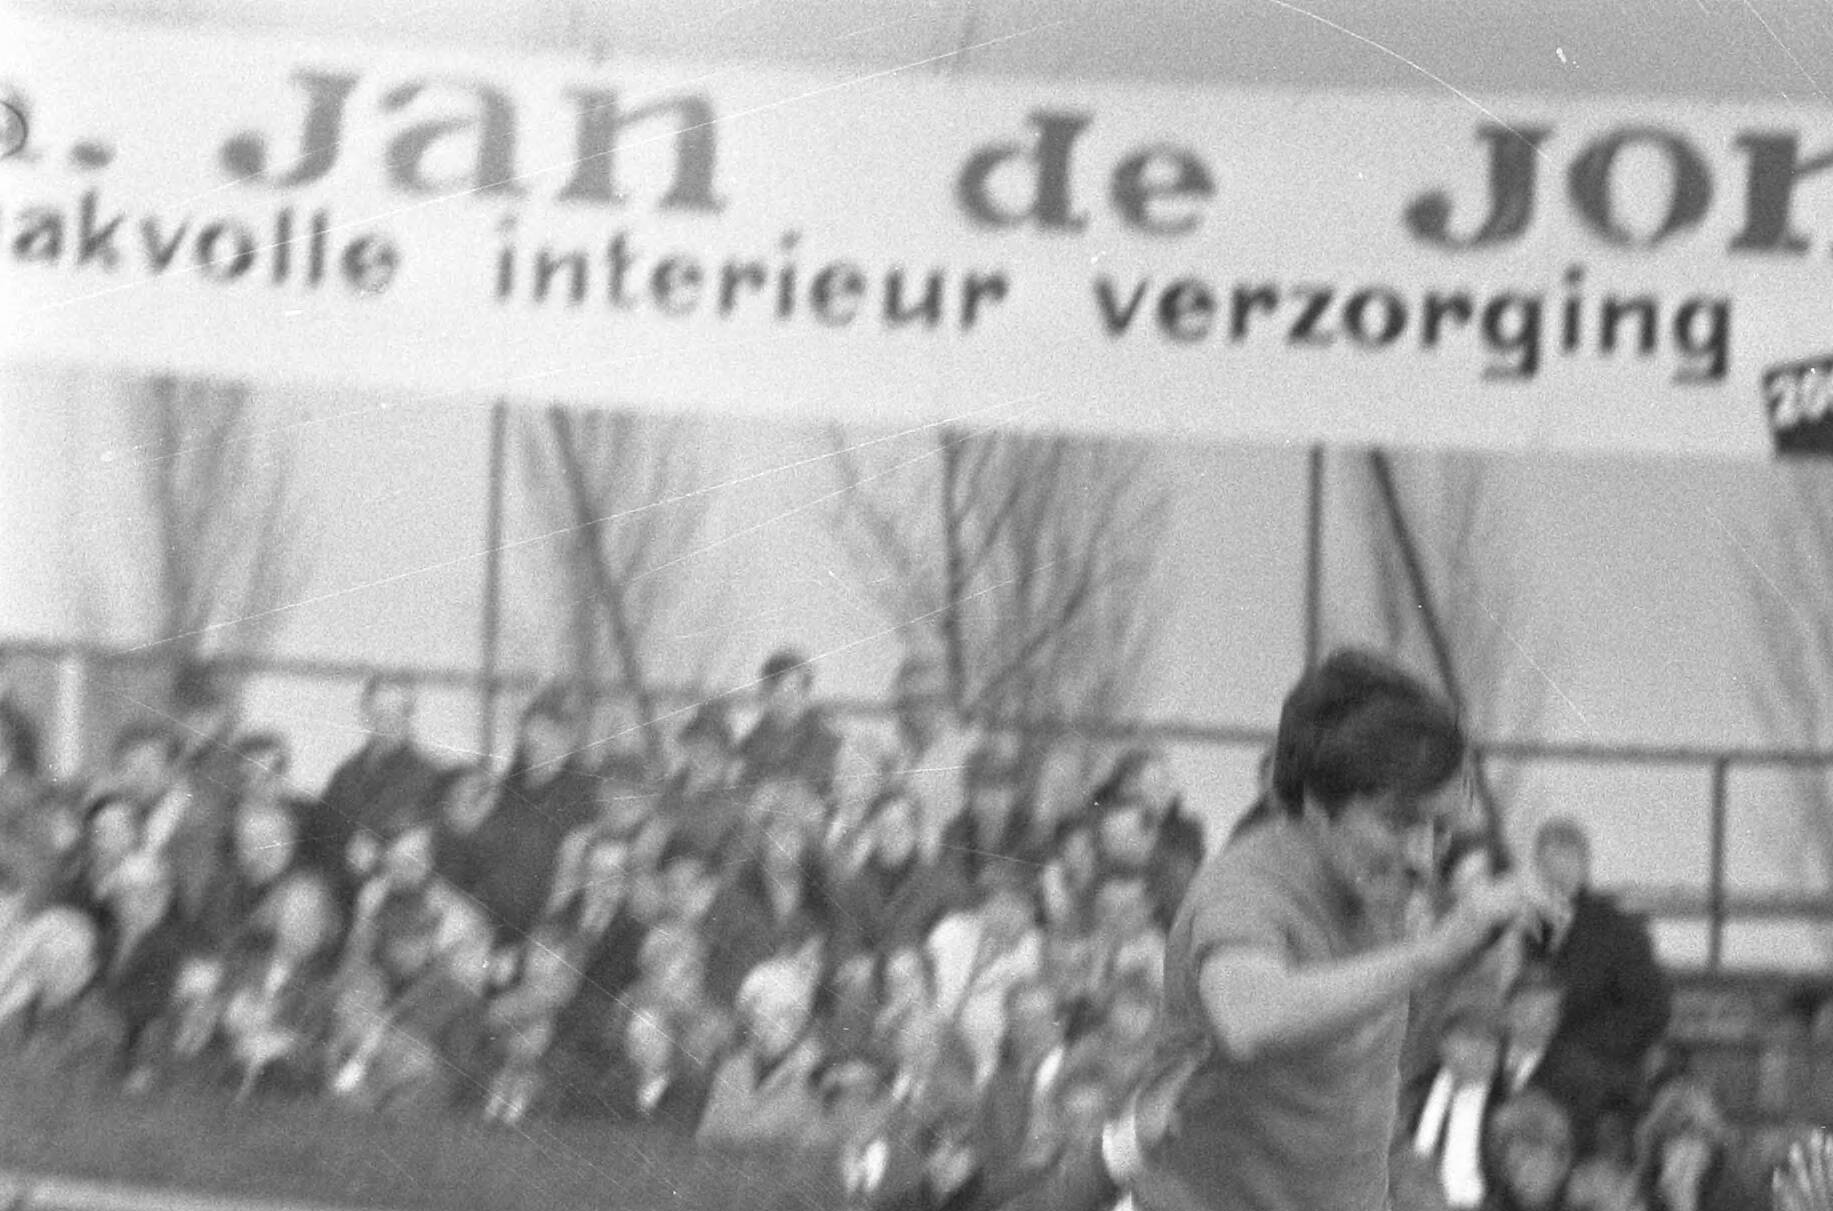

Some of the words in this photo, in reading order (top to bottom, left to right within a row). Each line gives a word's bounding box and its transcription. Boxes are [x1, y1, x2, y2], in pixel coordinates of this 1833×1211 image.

[217, 66, 728, 213] Jan
[953, 109, 1217, 238] de
[11, 189, 402, 293] akvolle
[495, 210, 1009, 333] interieur
[1093, 265, 1733, 384] verzorging
